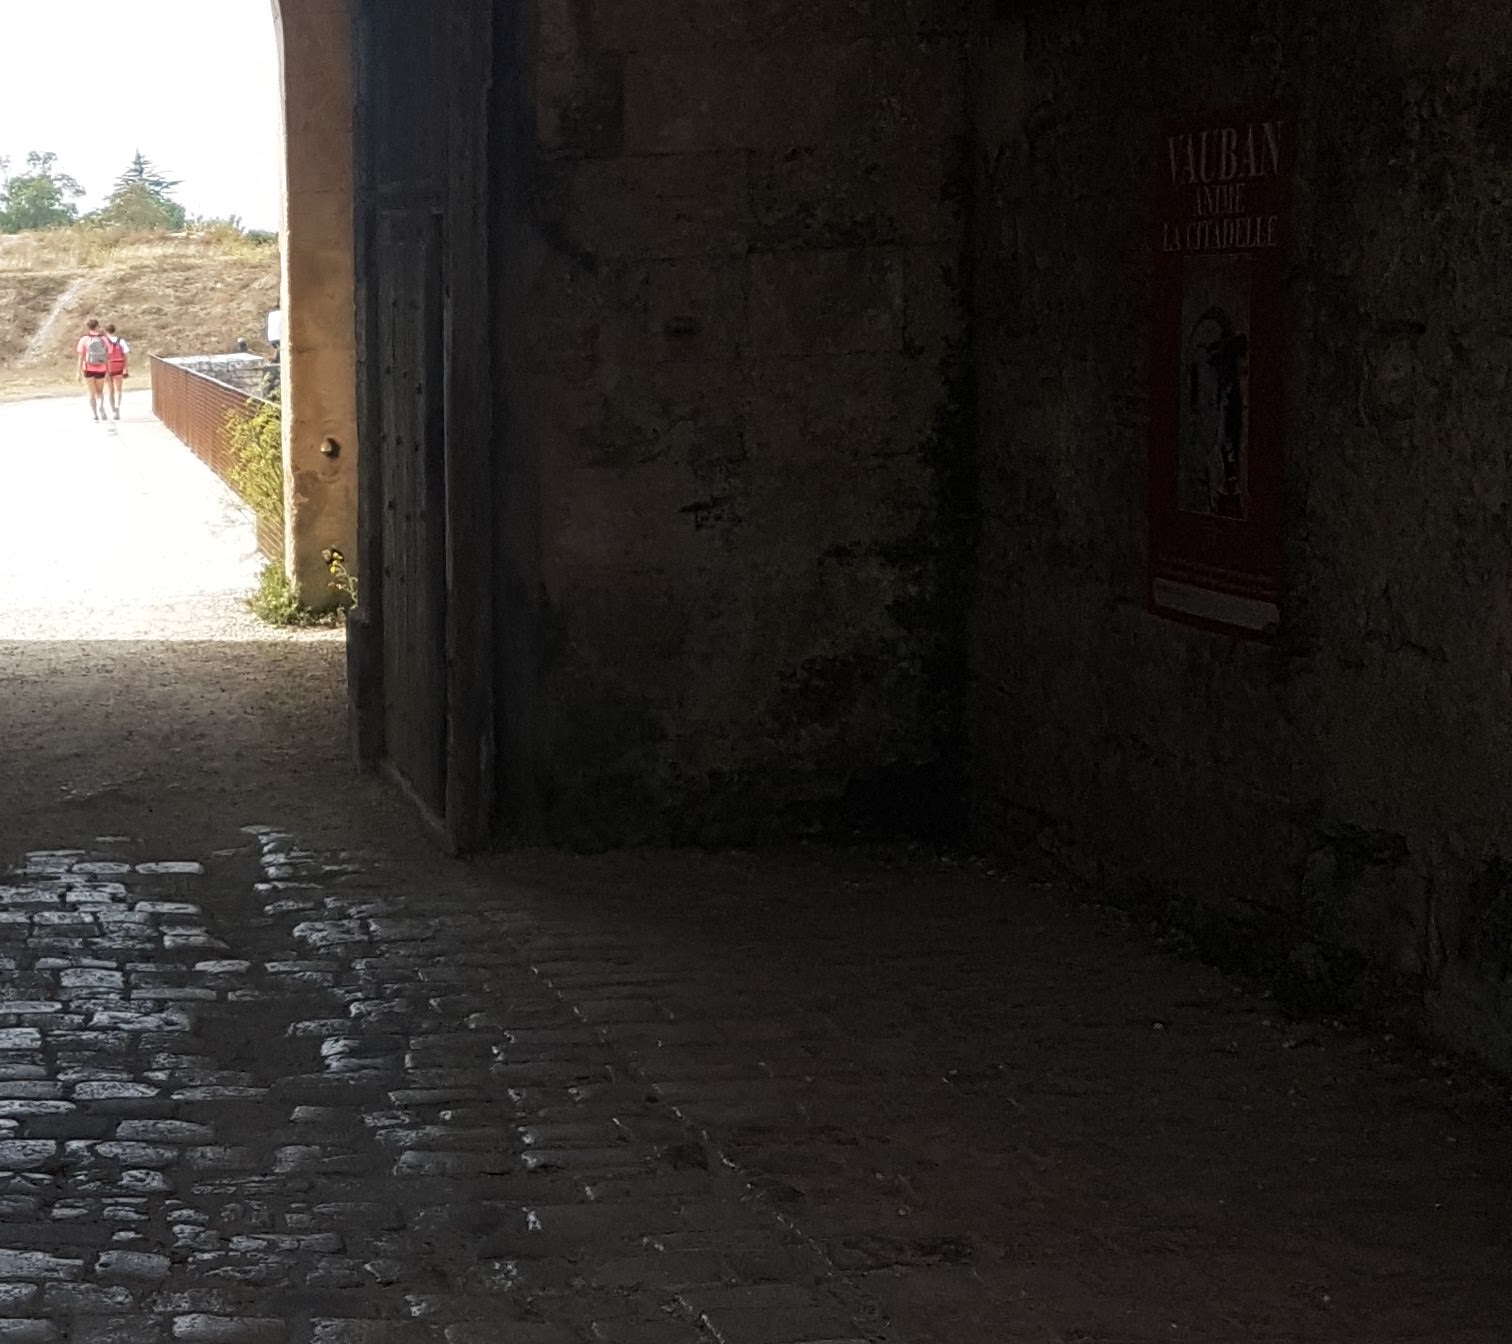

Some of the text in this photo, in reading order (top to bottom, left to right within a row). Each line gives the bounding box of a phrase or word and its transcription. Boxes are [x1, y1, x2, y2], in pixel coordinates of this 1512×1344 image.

[1166, 120, 1285, 185] VAUBAN
[1162, 215, 1279, 252] LA CITADELLE
